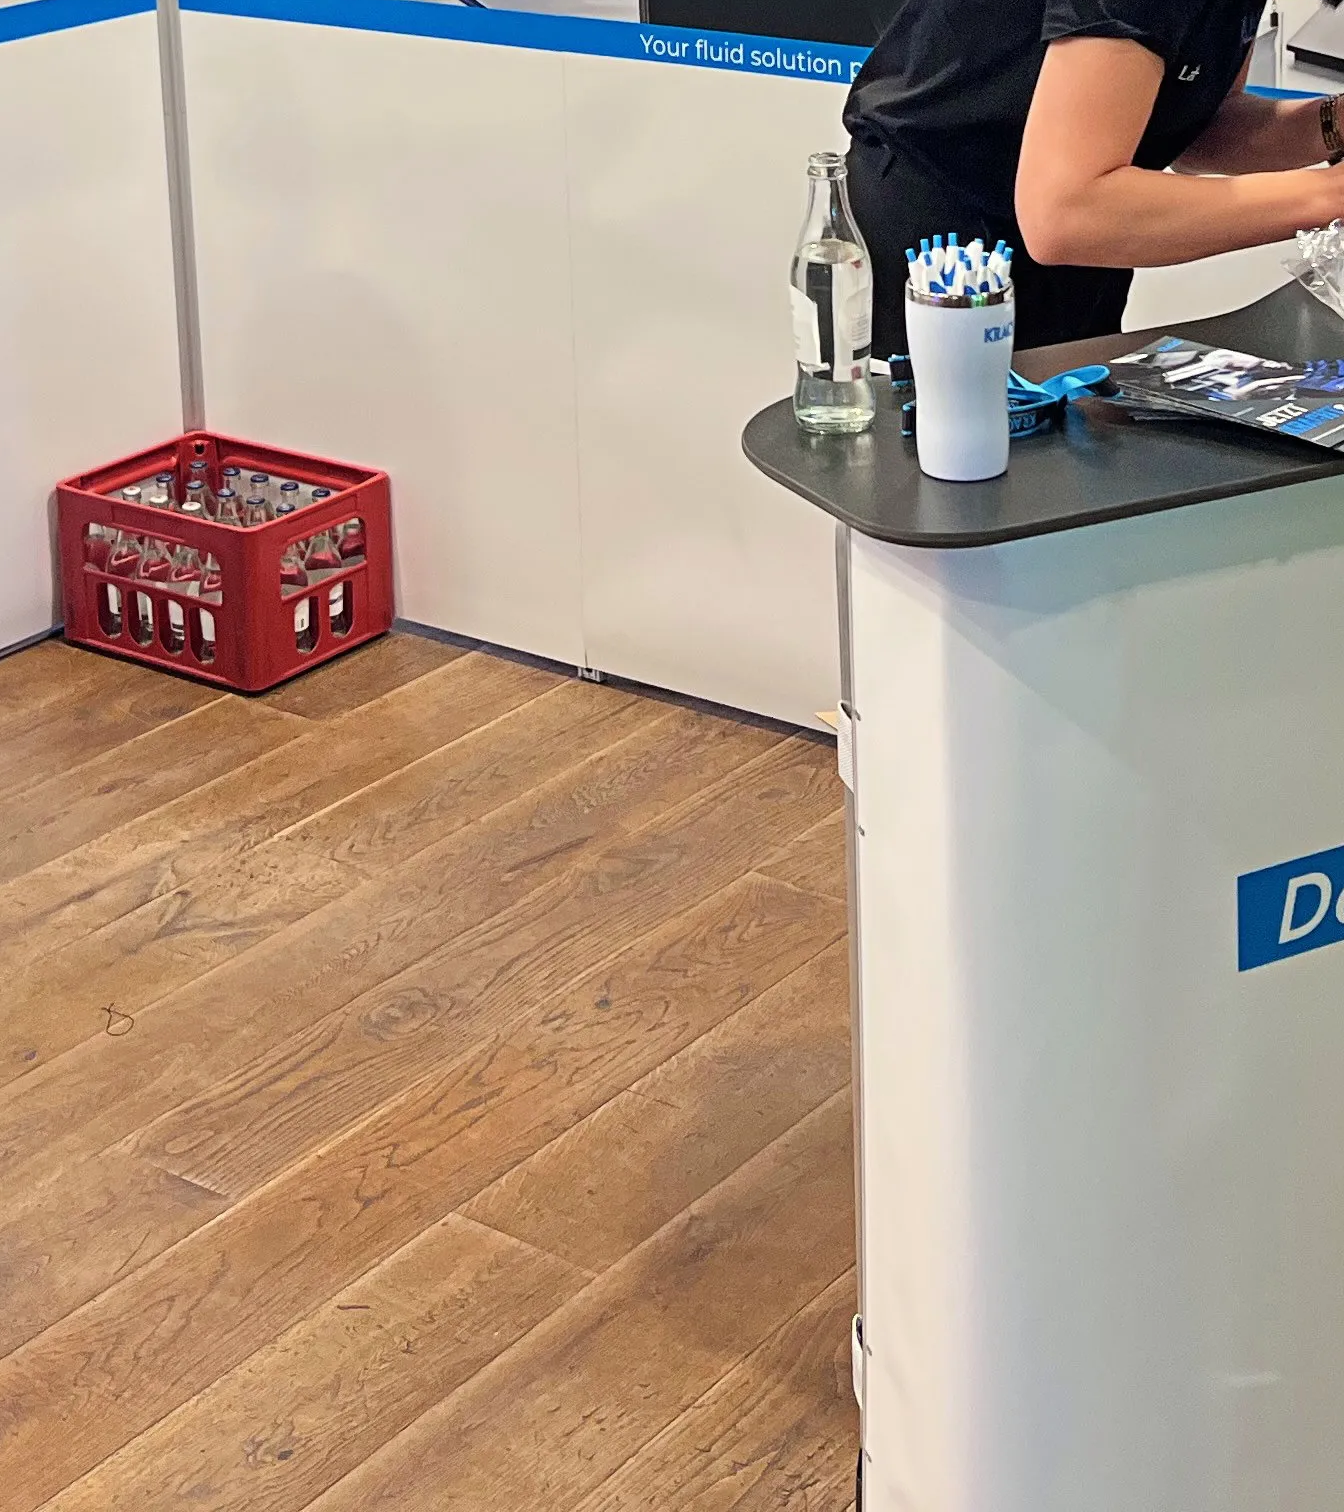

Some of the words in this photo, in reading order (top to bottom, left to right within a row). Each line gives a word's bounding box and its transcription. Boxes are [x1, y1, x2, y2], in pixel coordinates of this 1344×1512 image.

[640, 34, 689, 58] Your
[695, 39, 744, 65] fluid
[750, 47, 842, 76] solution
